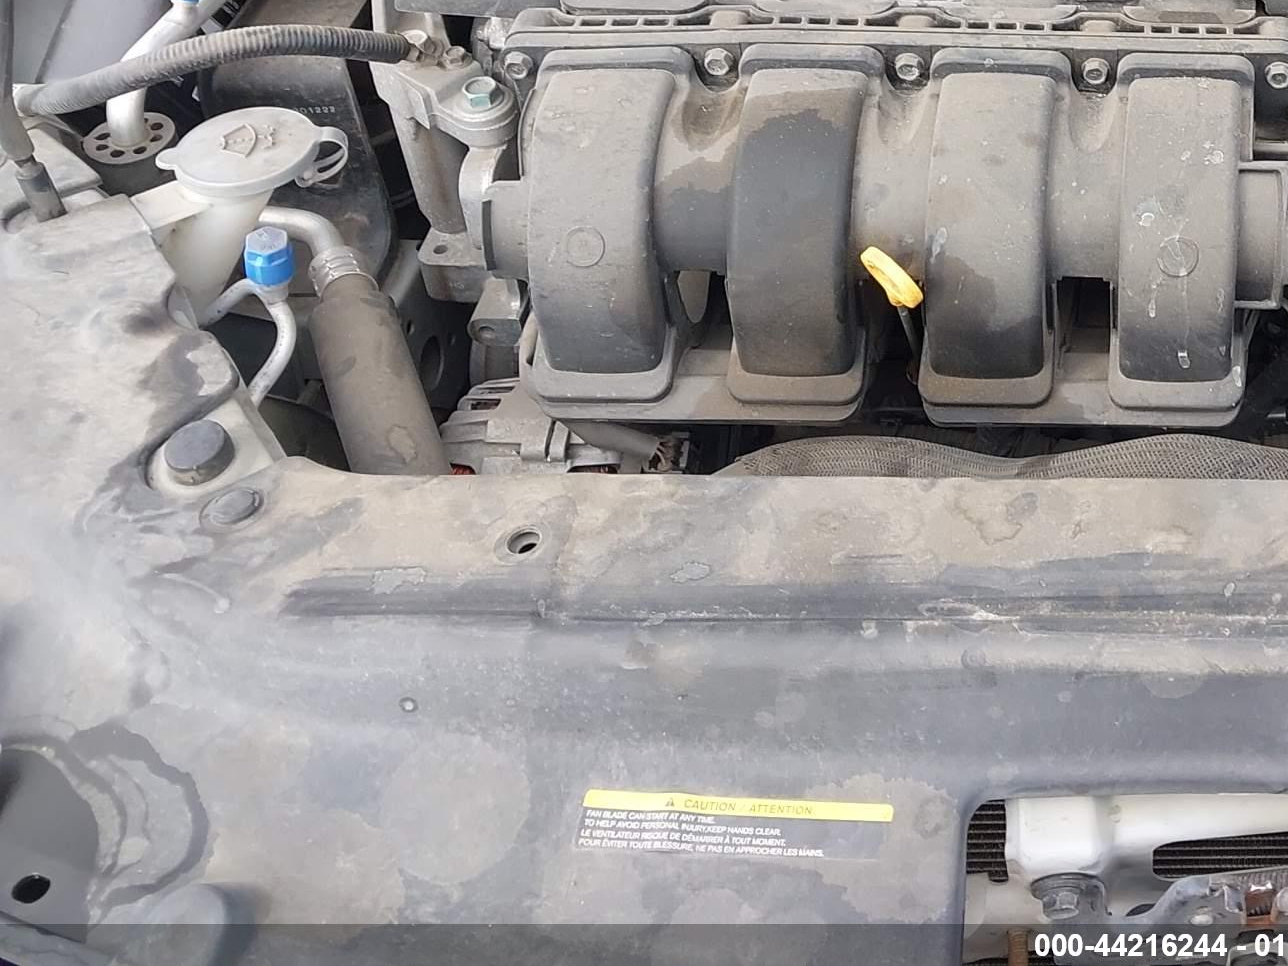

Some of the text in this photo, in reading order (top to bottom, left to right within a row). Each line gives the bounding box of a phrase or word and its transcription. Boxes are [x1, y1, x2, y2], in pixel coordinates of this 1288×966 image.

[586, 809, 601, 818] FAN
[602, 810, 627, 819] BLADE
[628, 811, 645, 820] CAN
[645, 811, 669, 821] START
[669, 812, 679, 821] AT
[679, 813, 696, 822] ANY
[684, 799, 737, 812] CAUTION
[749, 804, 813, 815] ATTENTION
[584, 818, 595, 827] TO
[595, 819, 616, 828] HELP
[616, 820, 640, 829] AVOID
[640, 821, 679, 831] PERSONAL
[727, 826, 754, 835] HANDS
[581, 828, 592, 837] LE
[592, 829, 641, 840] VENTILATEUR
[641, 831, 668, 841] RISQUE
[669, 832, 681, 841] DE
[731, 836, 752, 845] TOUT
[578, 837, 602, 847] POUR
[602, 838, 628, 848] ÉVITER
[628, 840, 653, 849] TOUTE
[695, 844, 707, 853] NE
[707, 845, 723, 854] PAS
[723, 845, 736, 854] EN
[735, 846, 783, 856] APPROCHER
[783, 848, 798, 857] LES
